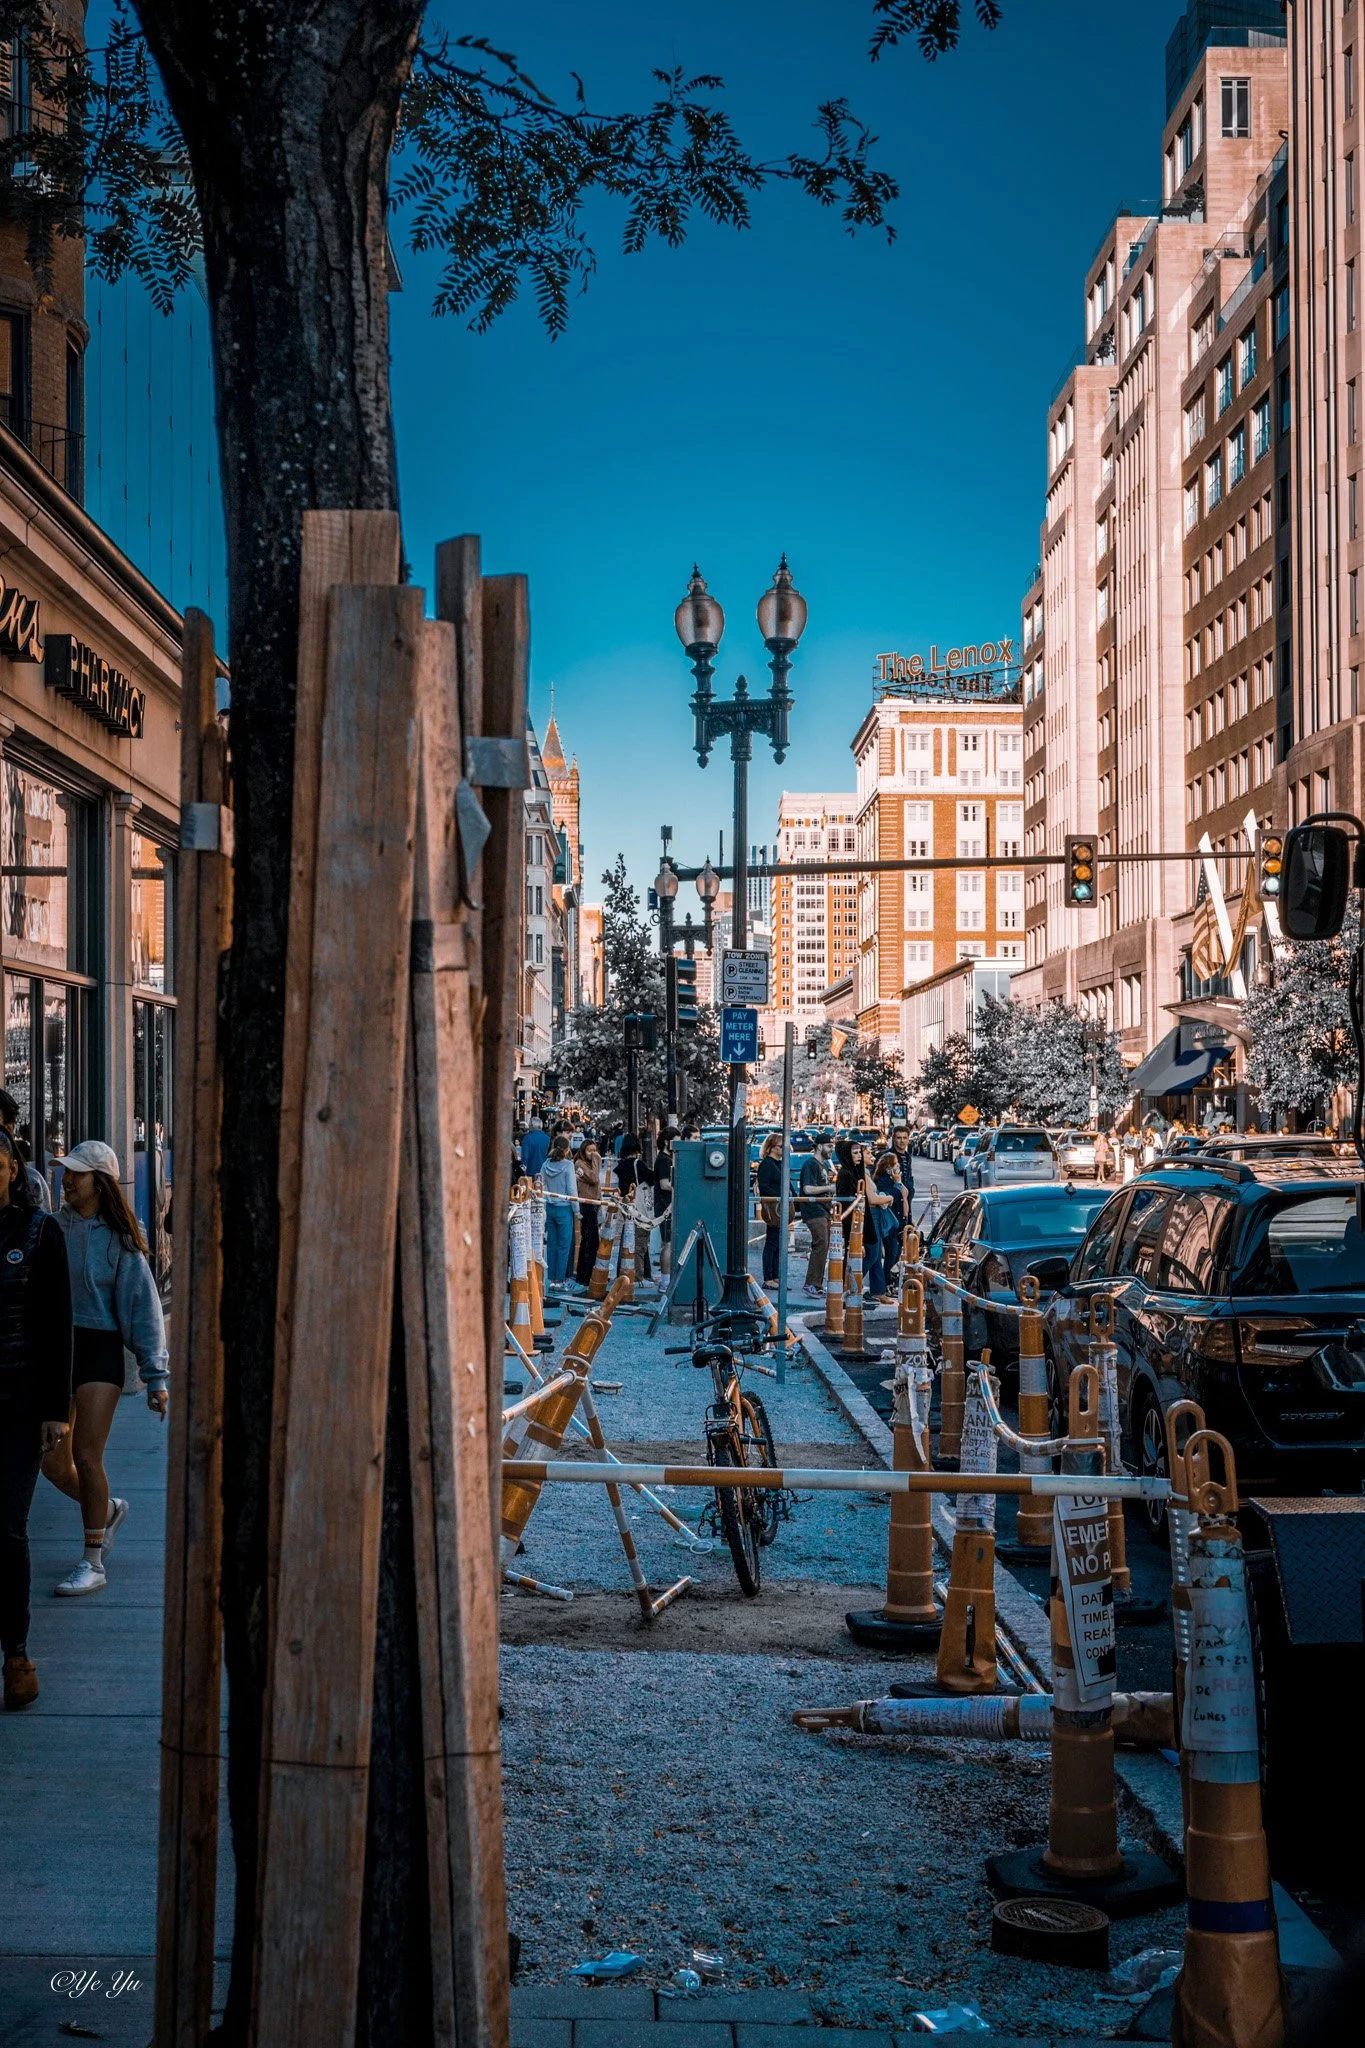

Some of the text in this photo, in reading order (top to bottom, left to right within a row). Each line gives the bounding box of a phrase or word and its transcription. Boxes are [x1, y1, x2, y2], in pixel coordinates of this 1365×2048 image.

[876, 639, 1013, 681] The Lenox
[66, 634, 145, 738] PHARMACY
[726, 951, 765, 960] TOW ZONE
[732, 1011, 748, 1020] PAY
[725, 1022, 754, 1031] METER
[728, 1032, 751, 1041] HERE
[1278, 1411, 1345, 1421] ODYSSEY
[1071, 1554, 1099, 1576] NO
[1081, 1592, 1104, 1606] DAT
